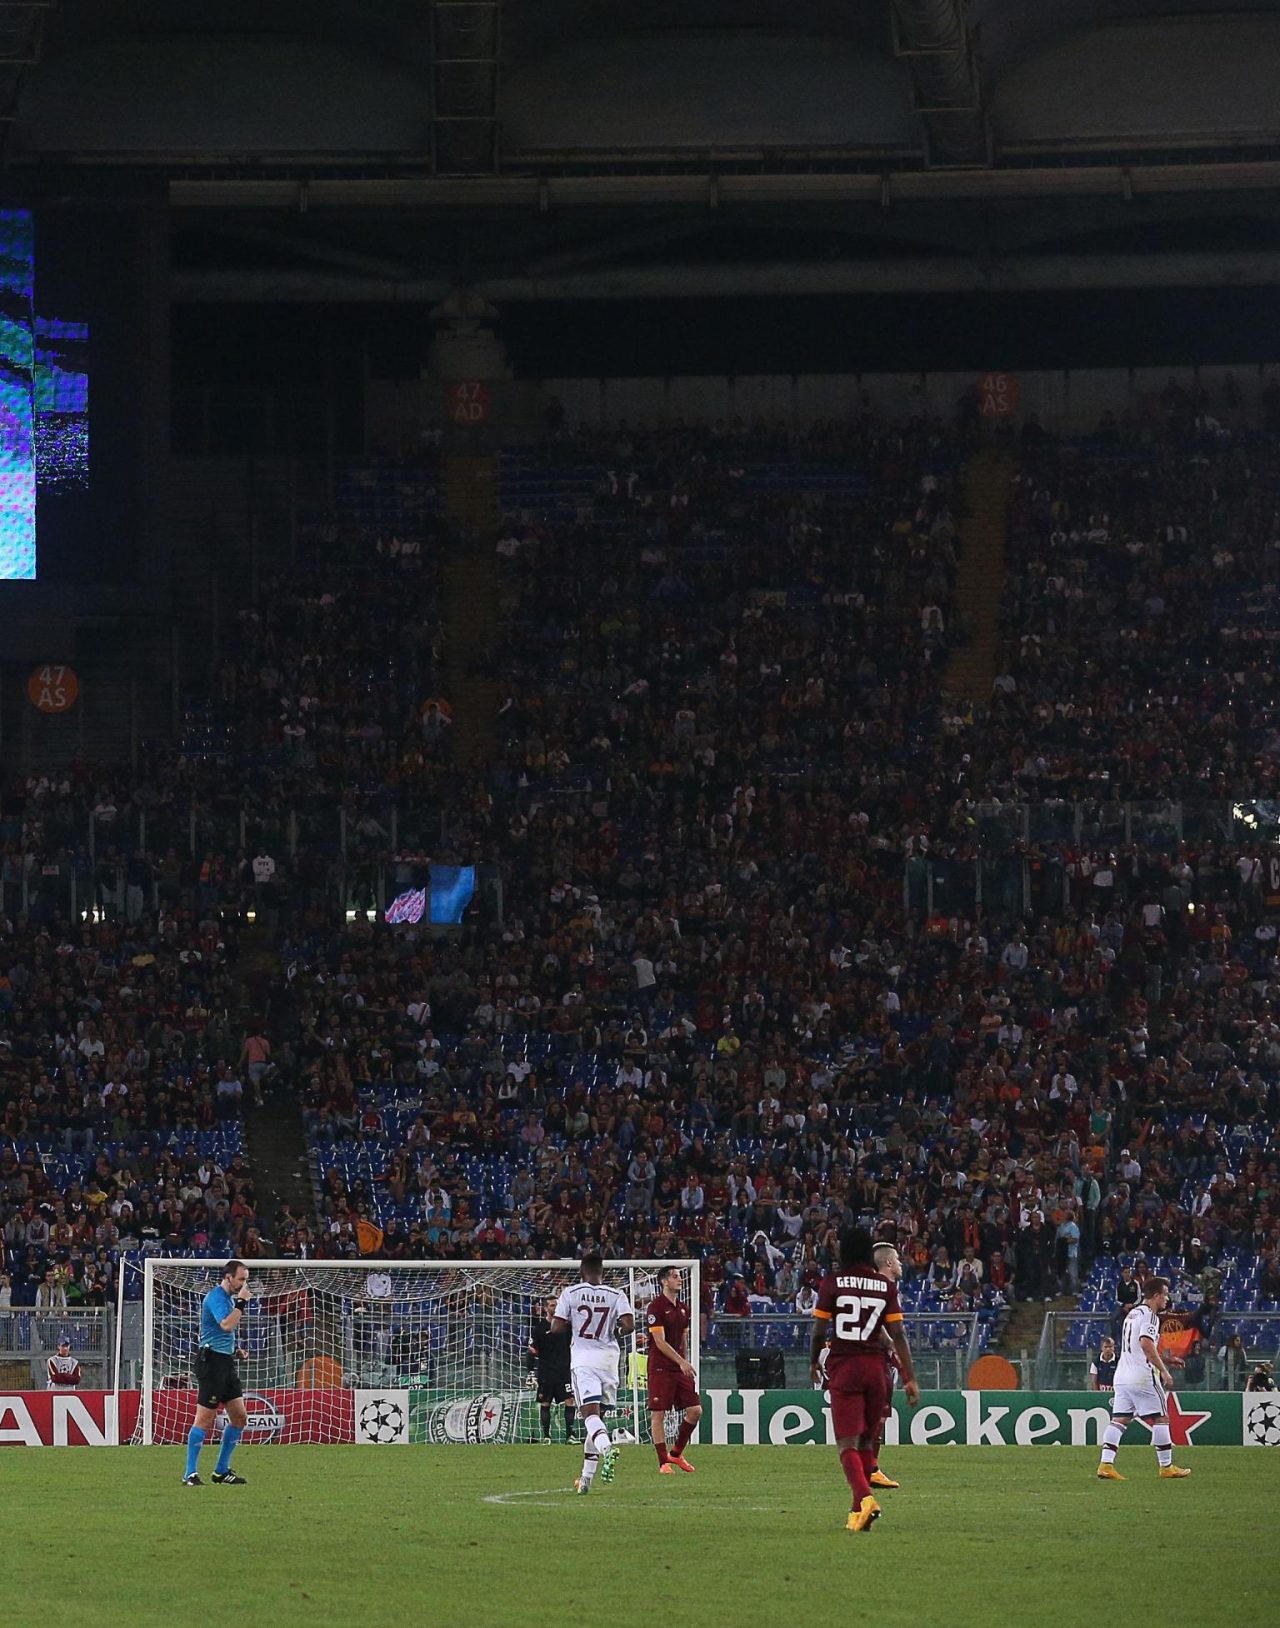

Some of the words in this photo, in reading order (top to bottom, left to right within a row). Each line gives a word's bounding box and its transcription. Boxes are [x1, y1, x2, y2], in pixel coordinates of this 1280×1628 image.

[457, 382, 481, 400] 47
[983, 374, 1008, 393] 46
[454, 402, 483, 421] AD
[983, 394, 1009, 413] AS
[39, 665, 66, 685] 47
[38, 687, 66, 707] AS
[835, 1275, 888, 1292] GERVINHO
[581, 1293, 606, 1303] ALABA
[577, 1304, 611, 1340] 27
[835, 1295, 887, 1341] 27
